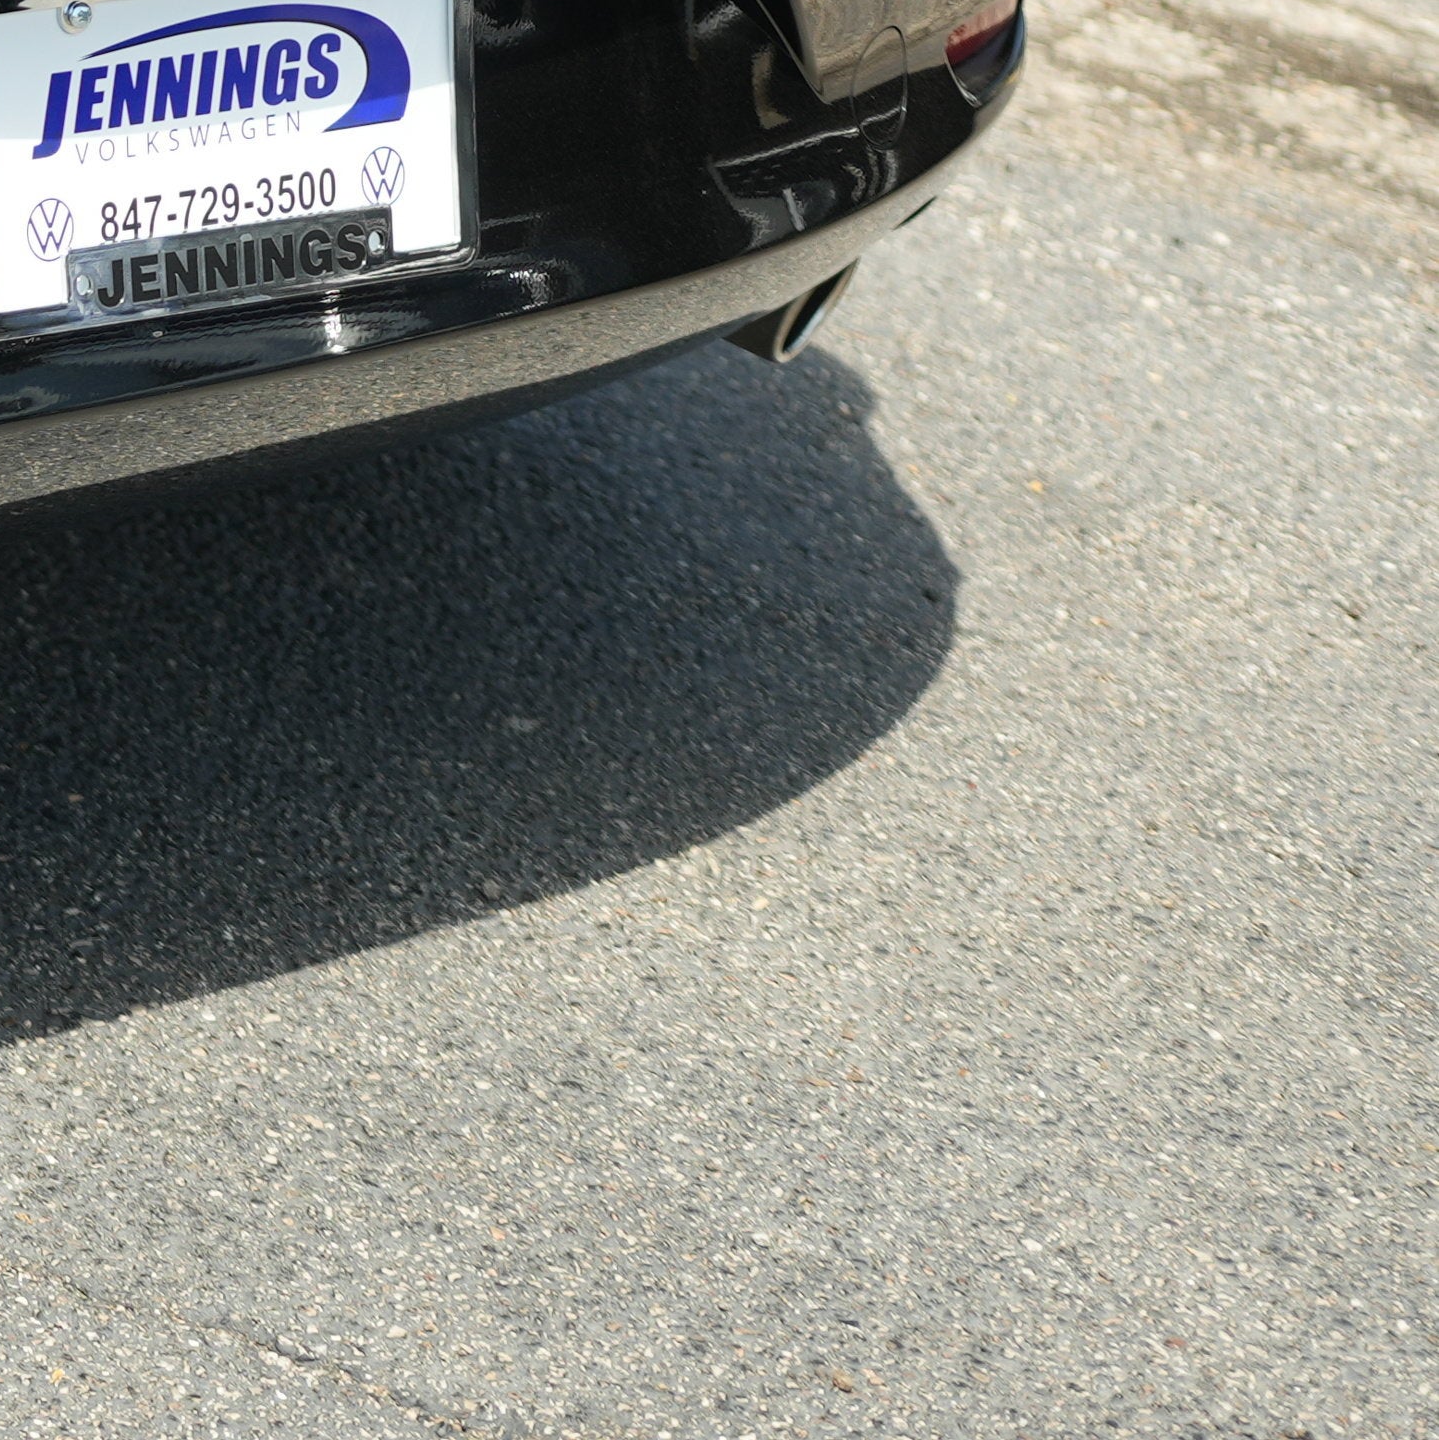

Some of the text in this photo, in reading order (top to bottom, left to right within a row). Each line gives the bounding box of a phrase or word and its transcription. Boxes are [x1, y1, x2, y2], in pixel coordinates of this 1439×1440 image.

[33, 32, 341, 160] JENNINGS
[75, 111, 301, 164] VOLKSWAGEN
[101, 168, 336, 241] 847-729-3500
[98, 223, 366, 307] JENNINGS
